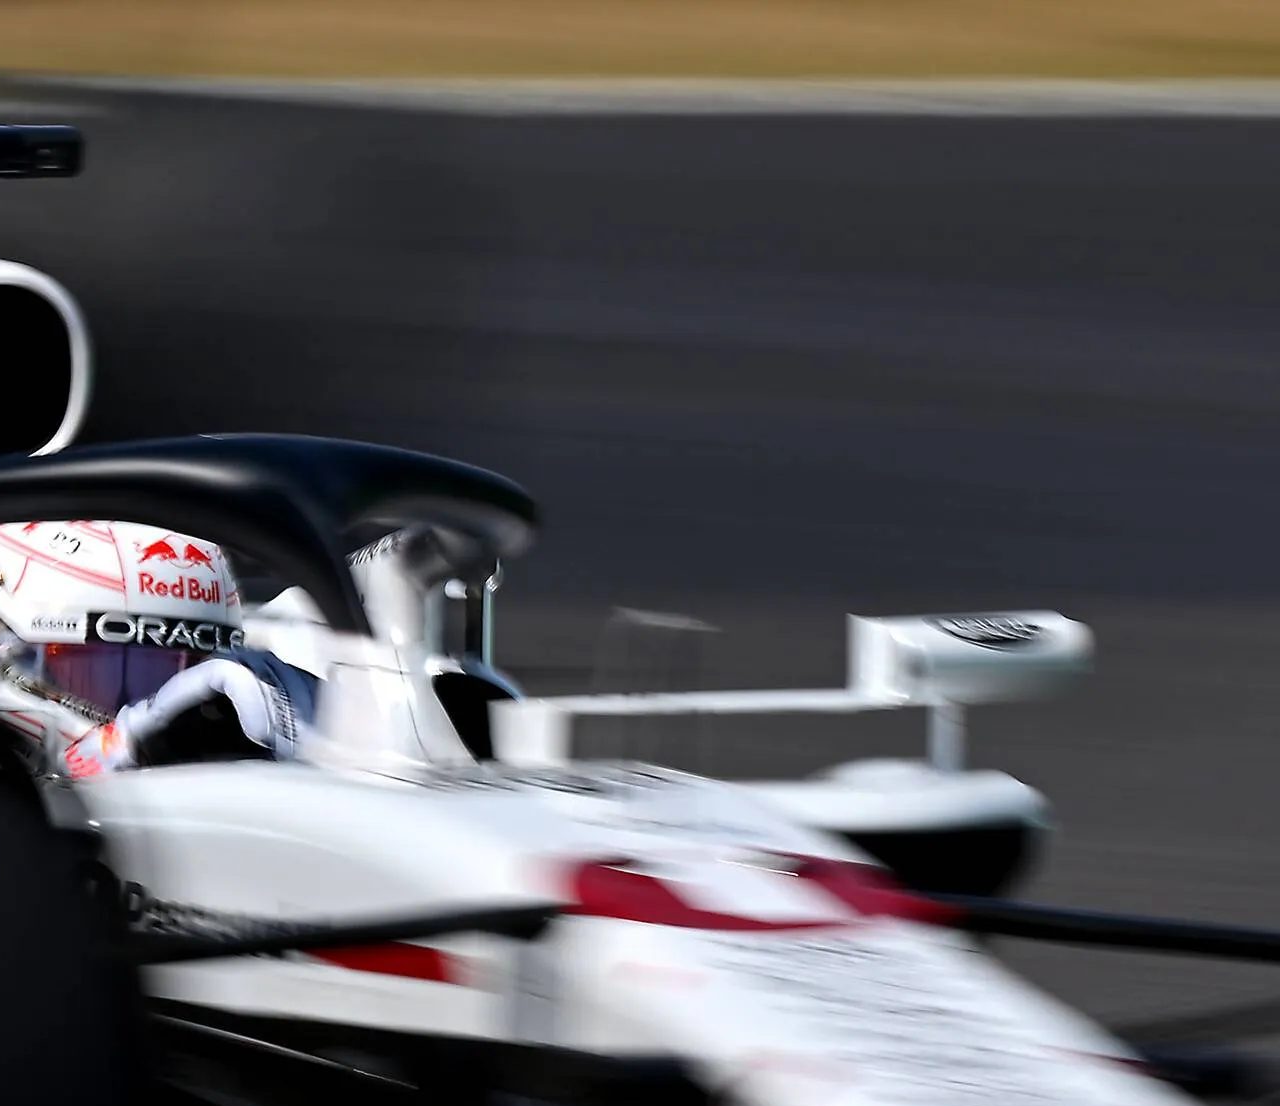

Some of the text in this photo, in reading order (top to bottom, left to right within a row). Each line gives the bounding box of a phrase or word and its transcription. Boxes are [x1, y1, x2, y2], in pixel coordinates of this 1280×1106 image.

[138, 571, 220, 604] Red Bull
[96, 612, 245, 652] ORACLE
